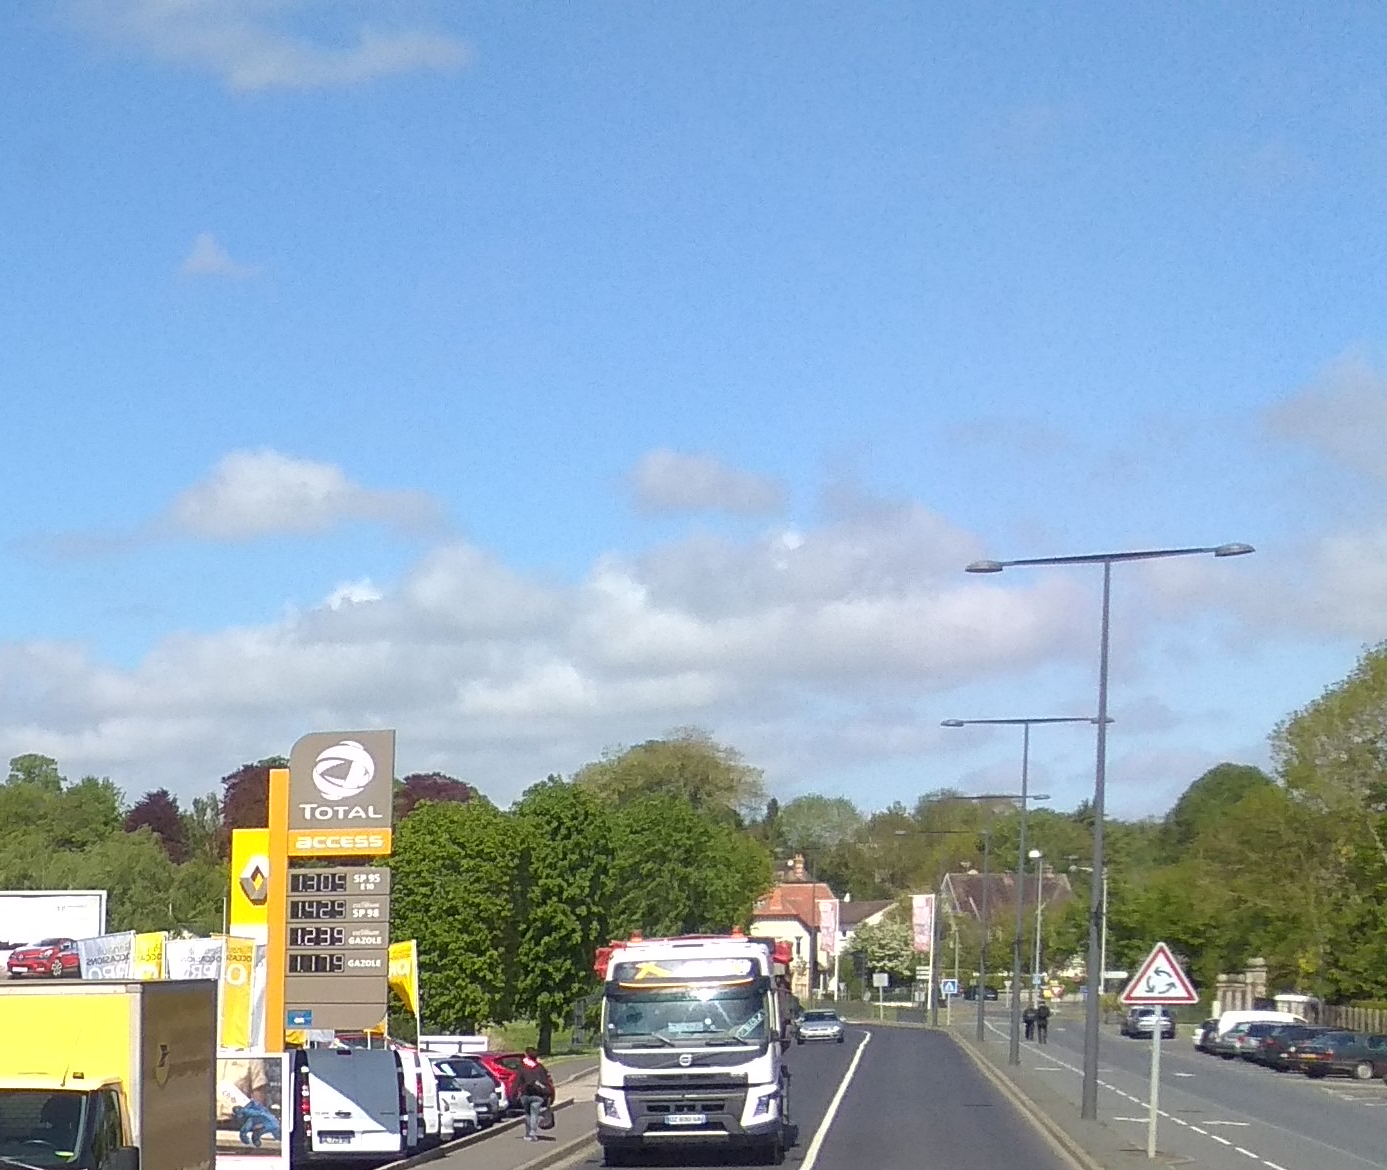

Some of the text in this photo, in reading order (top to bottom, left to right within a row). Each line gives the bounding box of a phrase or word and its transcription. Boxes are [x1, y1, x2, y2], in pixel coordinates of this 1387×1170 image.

[299, 803, 383, 820] TOTAL
[298, 873, 345, 892] 1.305
[353, 873, 381, 883] SP 95
[298, 900, 345, 919] 1.429
[352, 908, 380, 918] SP 98
[297, 927, 345, 946] 1.239
[348, 936, 382, 944] GAZOLE
[297, 954, 344, 973] 1.179
[347, 959, 382, 967] GAZOLE
